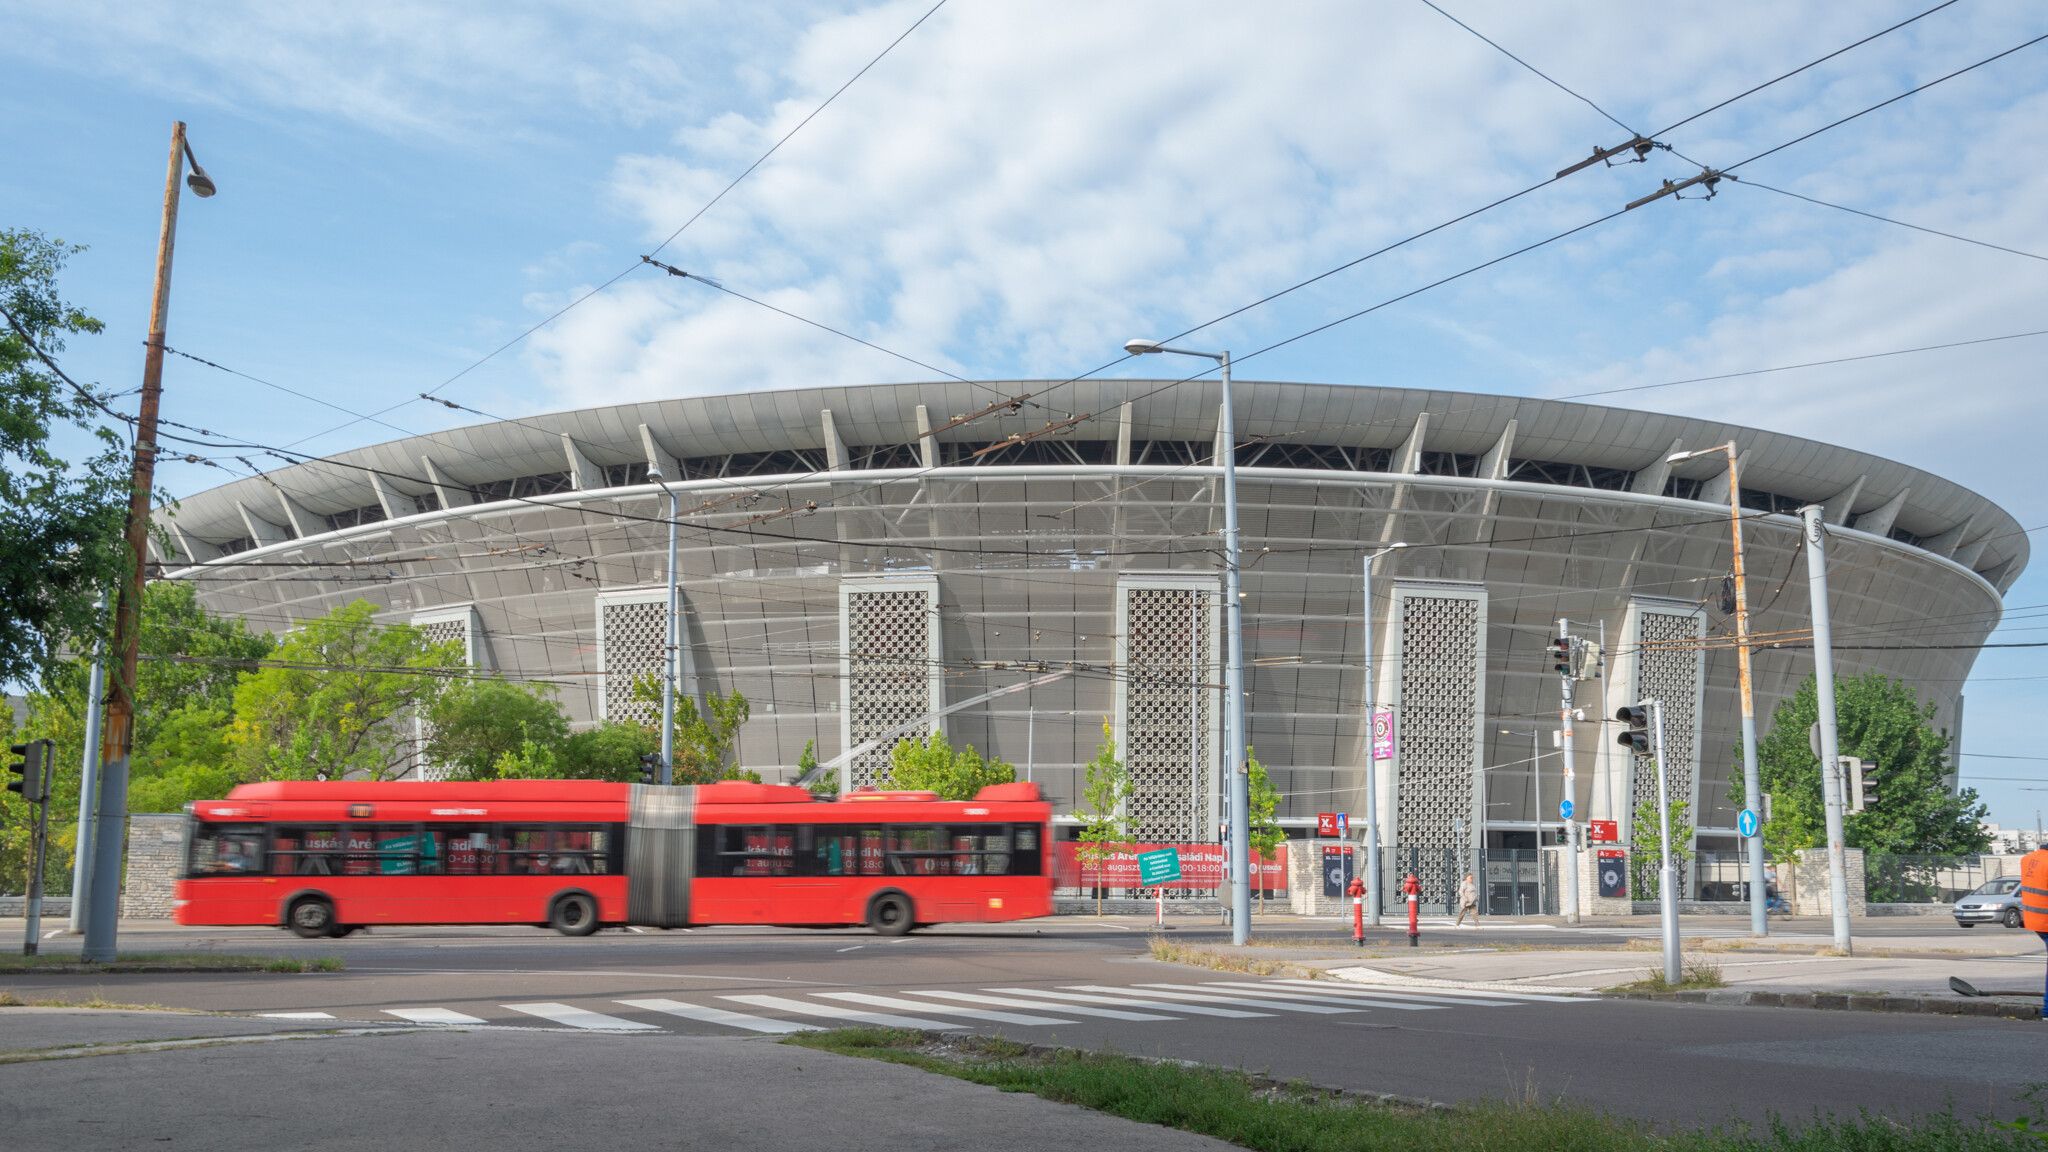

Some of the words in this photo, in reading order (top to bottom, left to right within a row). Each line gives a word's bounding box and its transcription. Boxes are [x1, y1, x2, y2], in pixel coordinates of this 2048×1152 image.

[1177, 852, 1203, 861] saládi
[1205, 853, 1222, 864] Nap
[1107, 863, 1140, 872] auguszt
